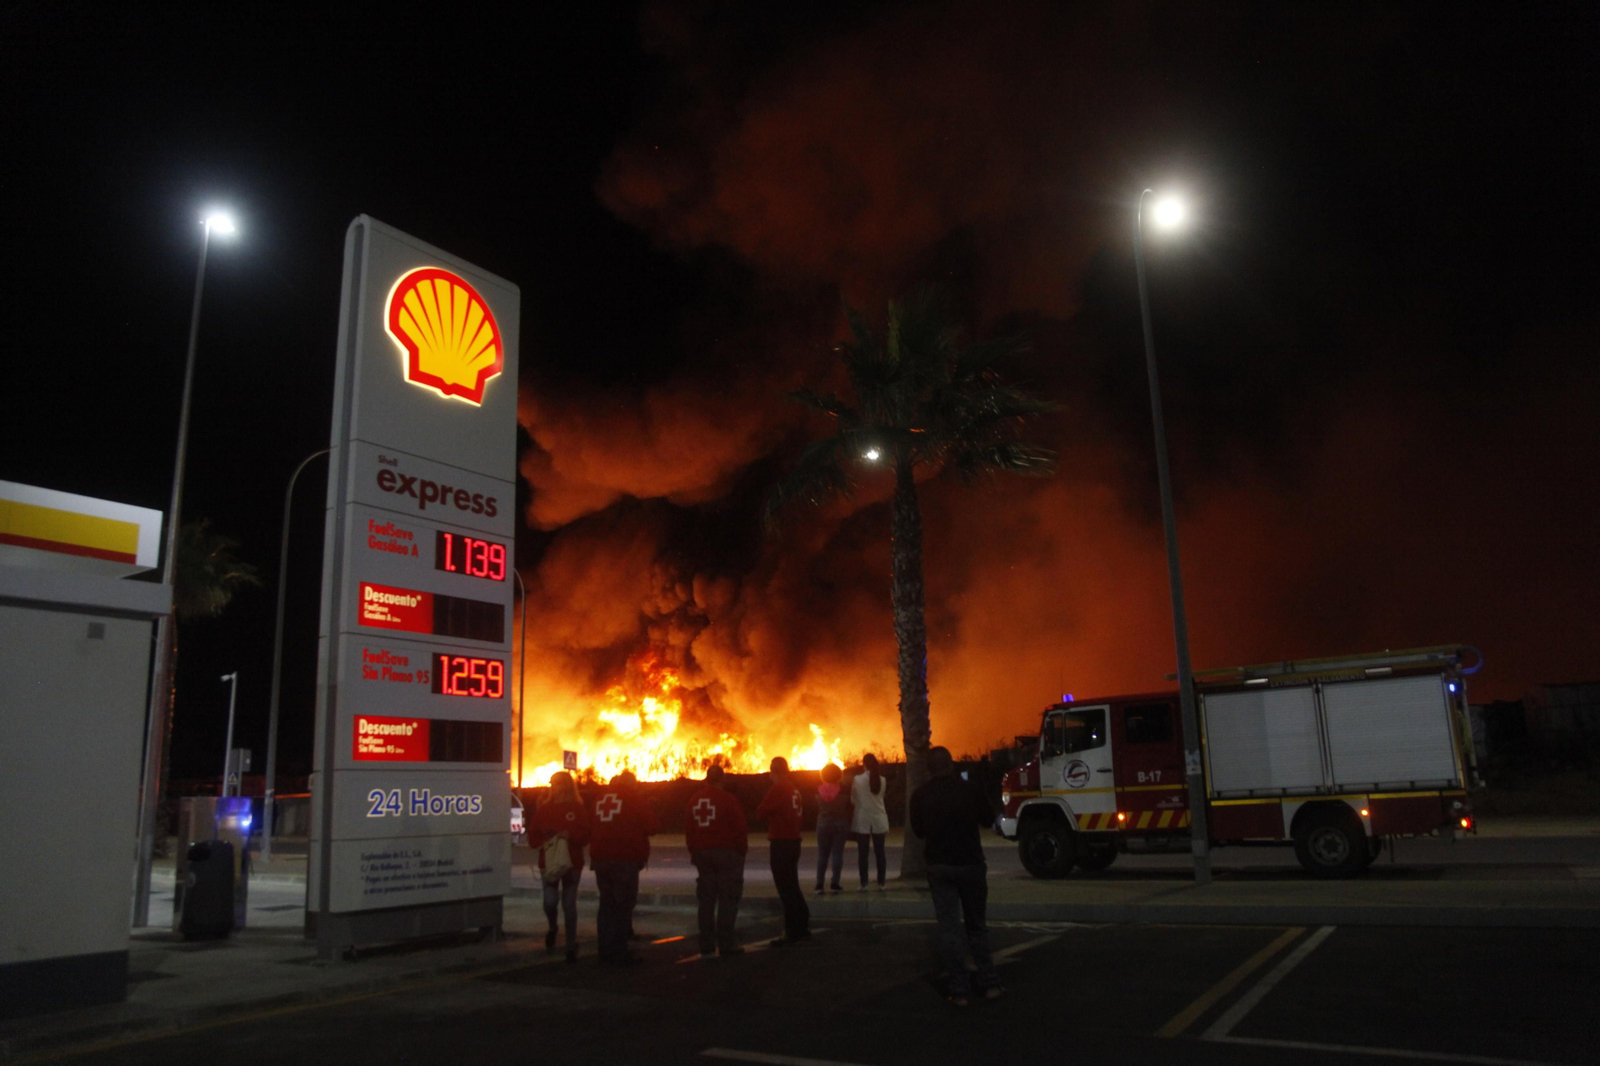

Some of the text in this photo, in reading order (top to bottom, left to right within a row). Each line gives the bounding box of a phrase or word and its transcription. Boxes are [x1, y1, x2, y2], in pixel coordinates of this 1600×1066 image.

[379, 455, 397, 467] Shell
[377, 469, 497, 517] express
[368, 519, 413, 540] FuelSave
[411, 543, 419, 557] A
[444, 533, 506, 580] 1.139
[363, 648, 408, 666] FuelSave
[363, 665, 430, 684] Sin Plomo 95
[1137, 770, 1162, 783] B-17
[367, 789, 482, 817] 24 Horas
